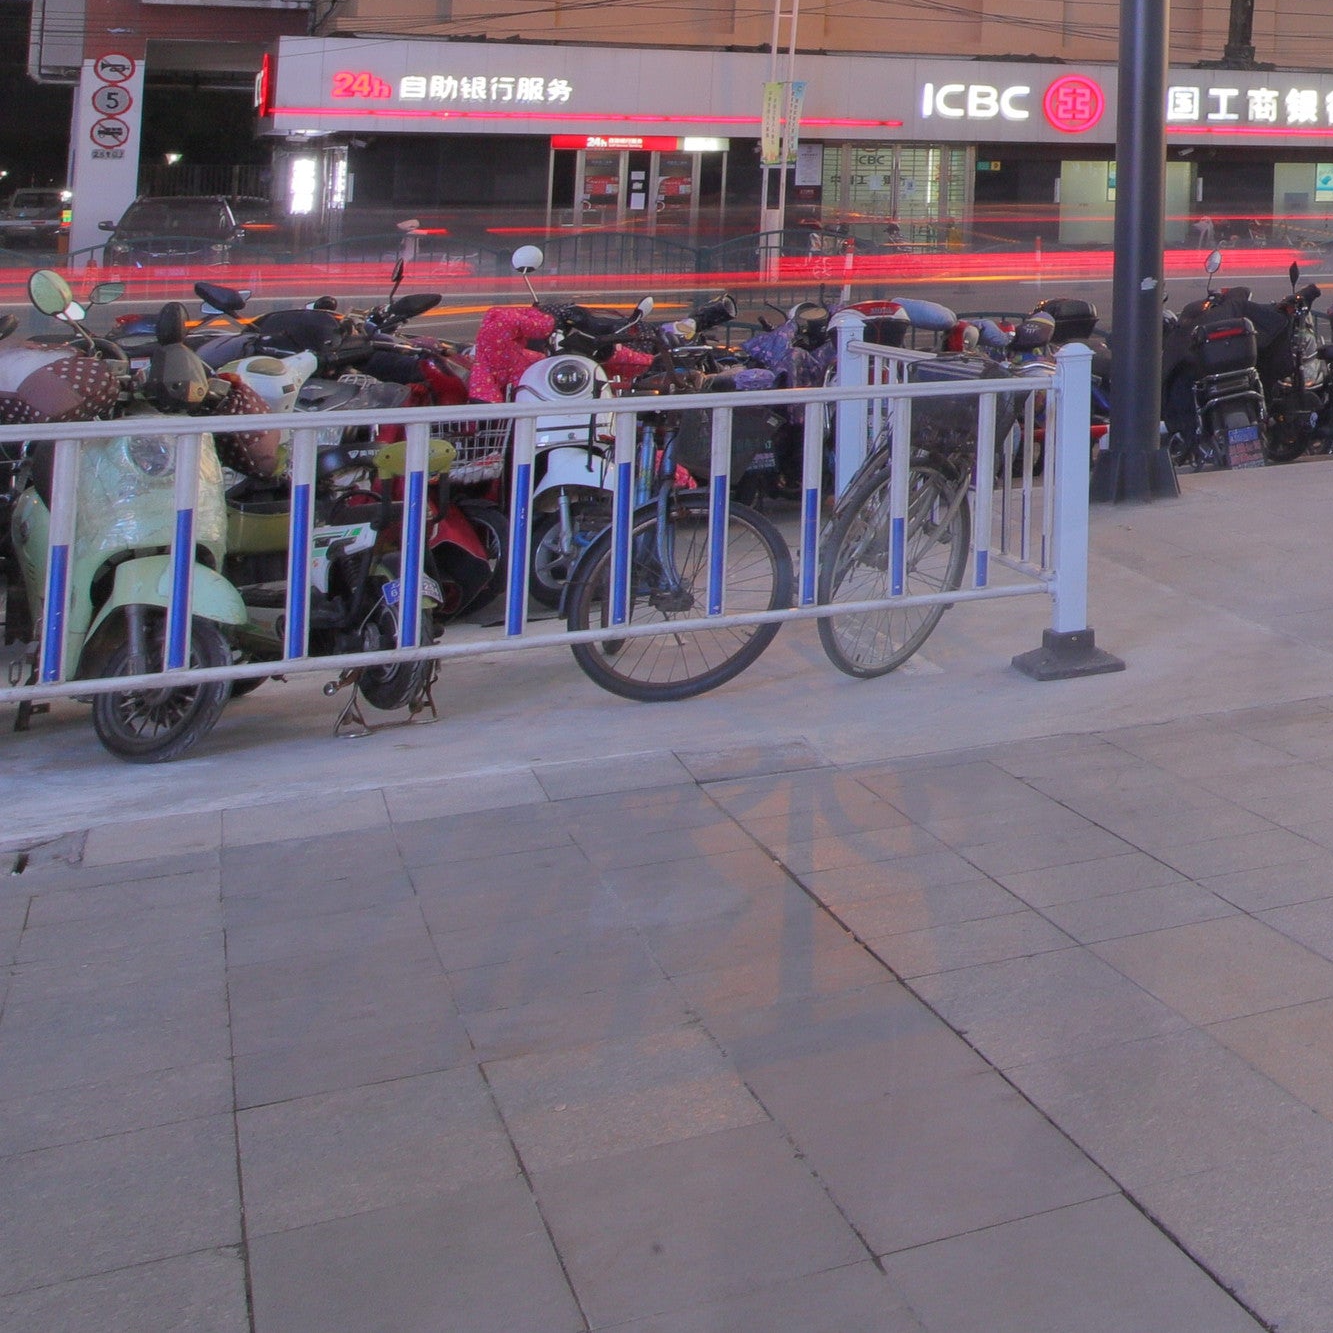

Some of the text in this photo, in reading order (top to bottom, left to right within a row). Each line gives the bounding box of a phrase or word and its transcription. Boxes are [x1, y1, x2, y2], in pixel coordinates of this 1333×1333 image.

[331, 71, 393, 100] 24h
[399, 75, 573, 103] 自助银行服务
[105, 92, 119, 109] 5
[922, 82, 1031, 121] ICBC
